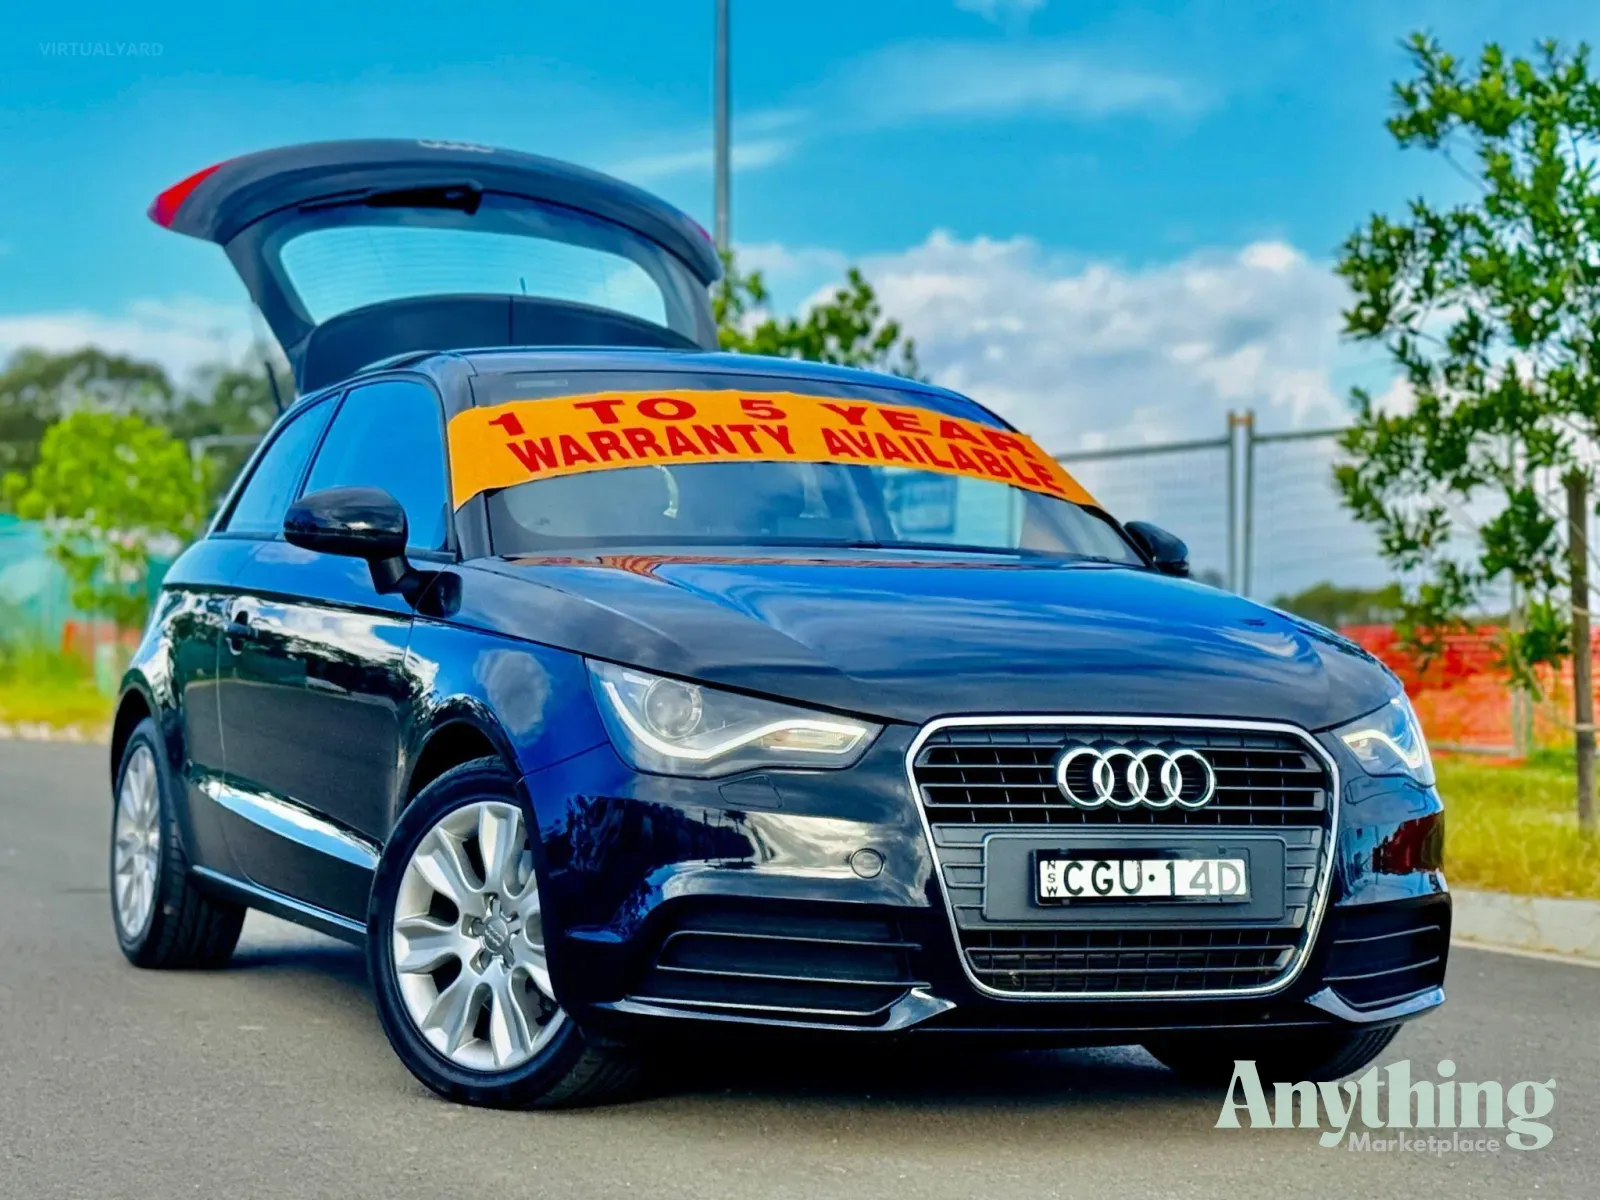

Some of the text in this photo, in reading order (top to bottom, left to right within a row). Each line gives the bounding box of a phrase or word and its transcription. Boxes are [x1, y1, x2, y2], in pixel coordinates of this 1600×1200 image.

[488, 397, 1037, 460] 1 TO 5 YEAR
[506, 423, 1068, 495] WARRANTY AVAILABLE
